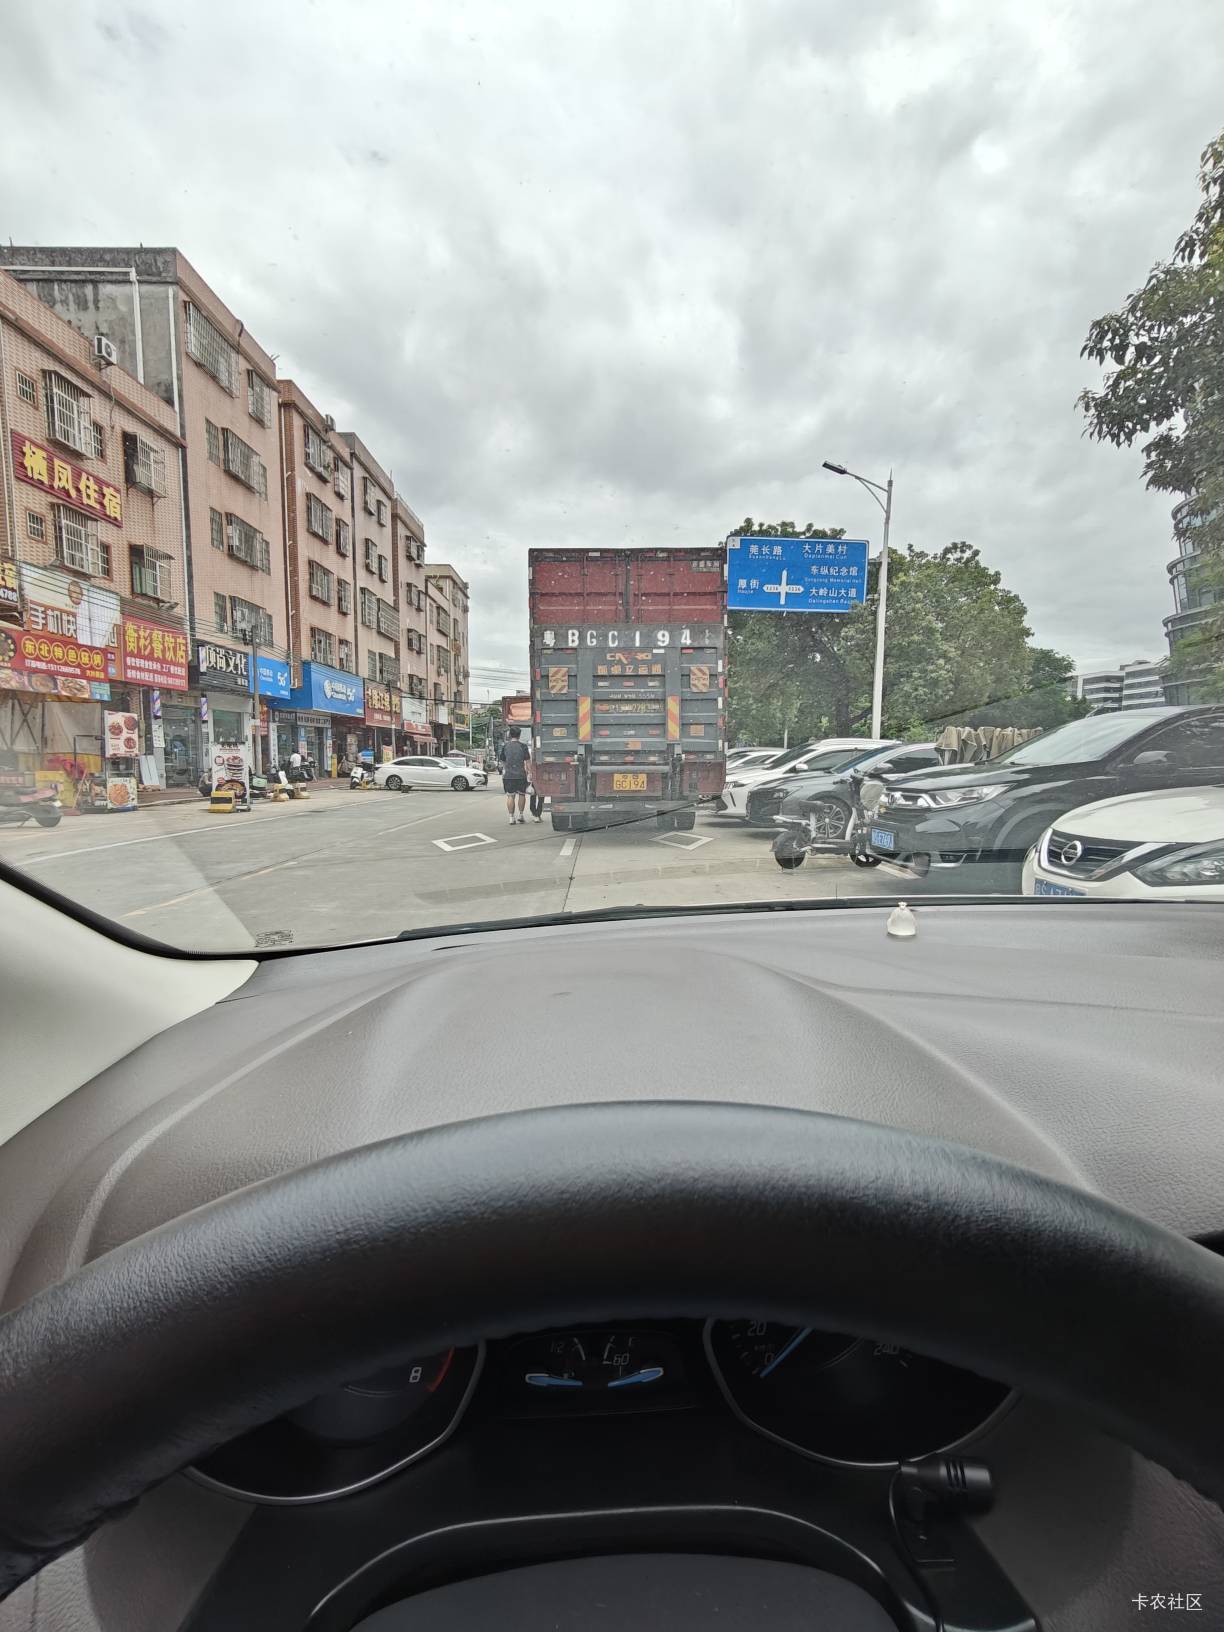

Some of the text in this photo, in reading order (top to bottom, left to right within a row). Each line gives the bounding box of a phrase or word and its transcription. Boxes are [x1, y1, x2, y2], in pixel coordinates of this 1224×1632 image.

[23, 440, 121, 520] 栖凤住宿
[802, 543, 848, 554] 大片美村
[810, 565, 858, 577] 东纵纪念馆
[738, 578, 760, 589] 厚街
[810, 587, 857, 598] 大岭山大道
[747, 1320, 767, 1336] 20
[409, 1366, 422, 1383] 8
